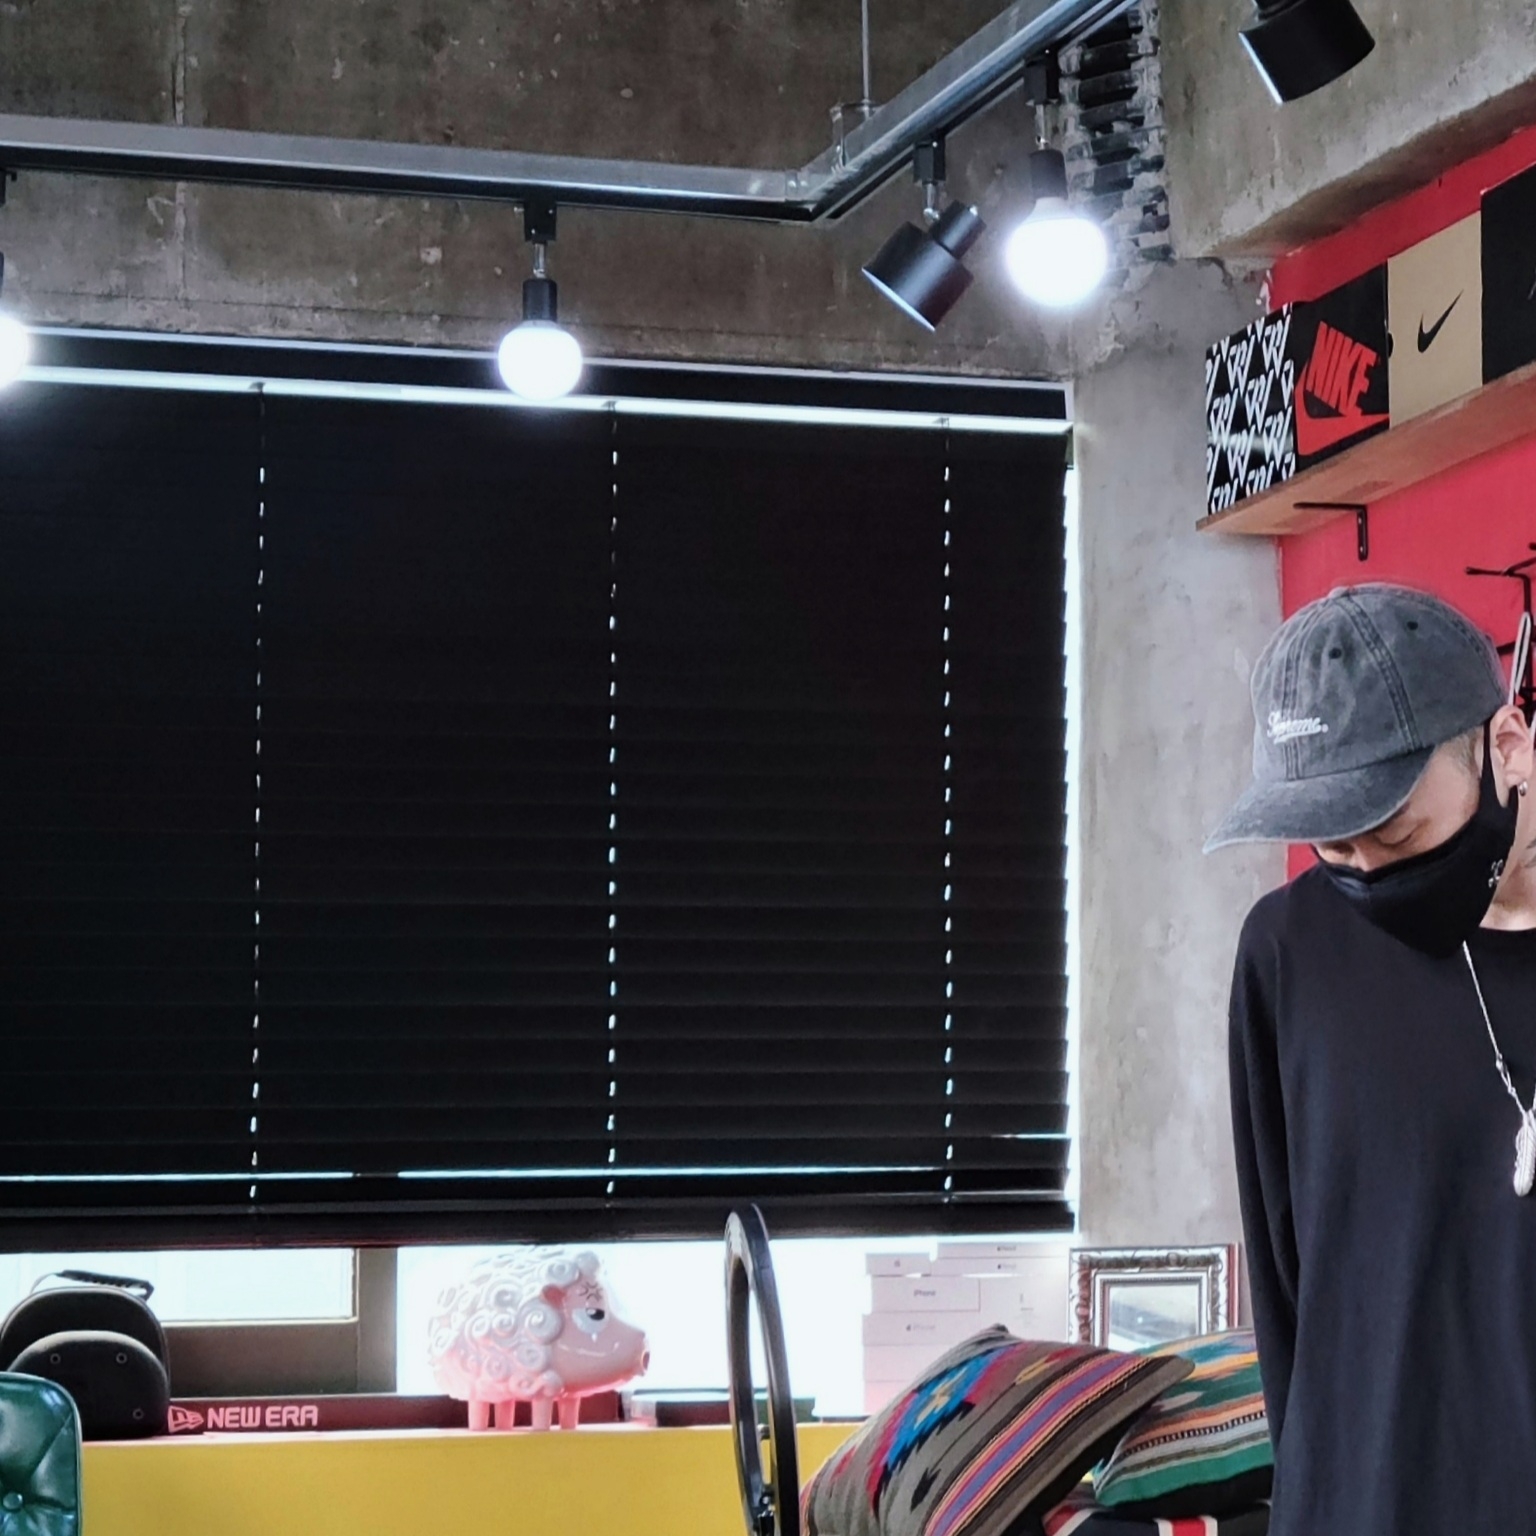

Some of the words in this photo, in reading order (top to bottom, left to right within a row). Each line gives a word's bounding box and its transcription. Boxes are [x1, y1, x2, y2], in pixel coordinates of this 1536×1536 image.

[1306, 320, 1378, 417] NIKE
[207, 1406, 262, 1429] NEW
[264, 1405, 319, 1428] ERA
